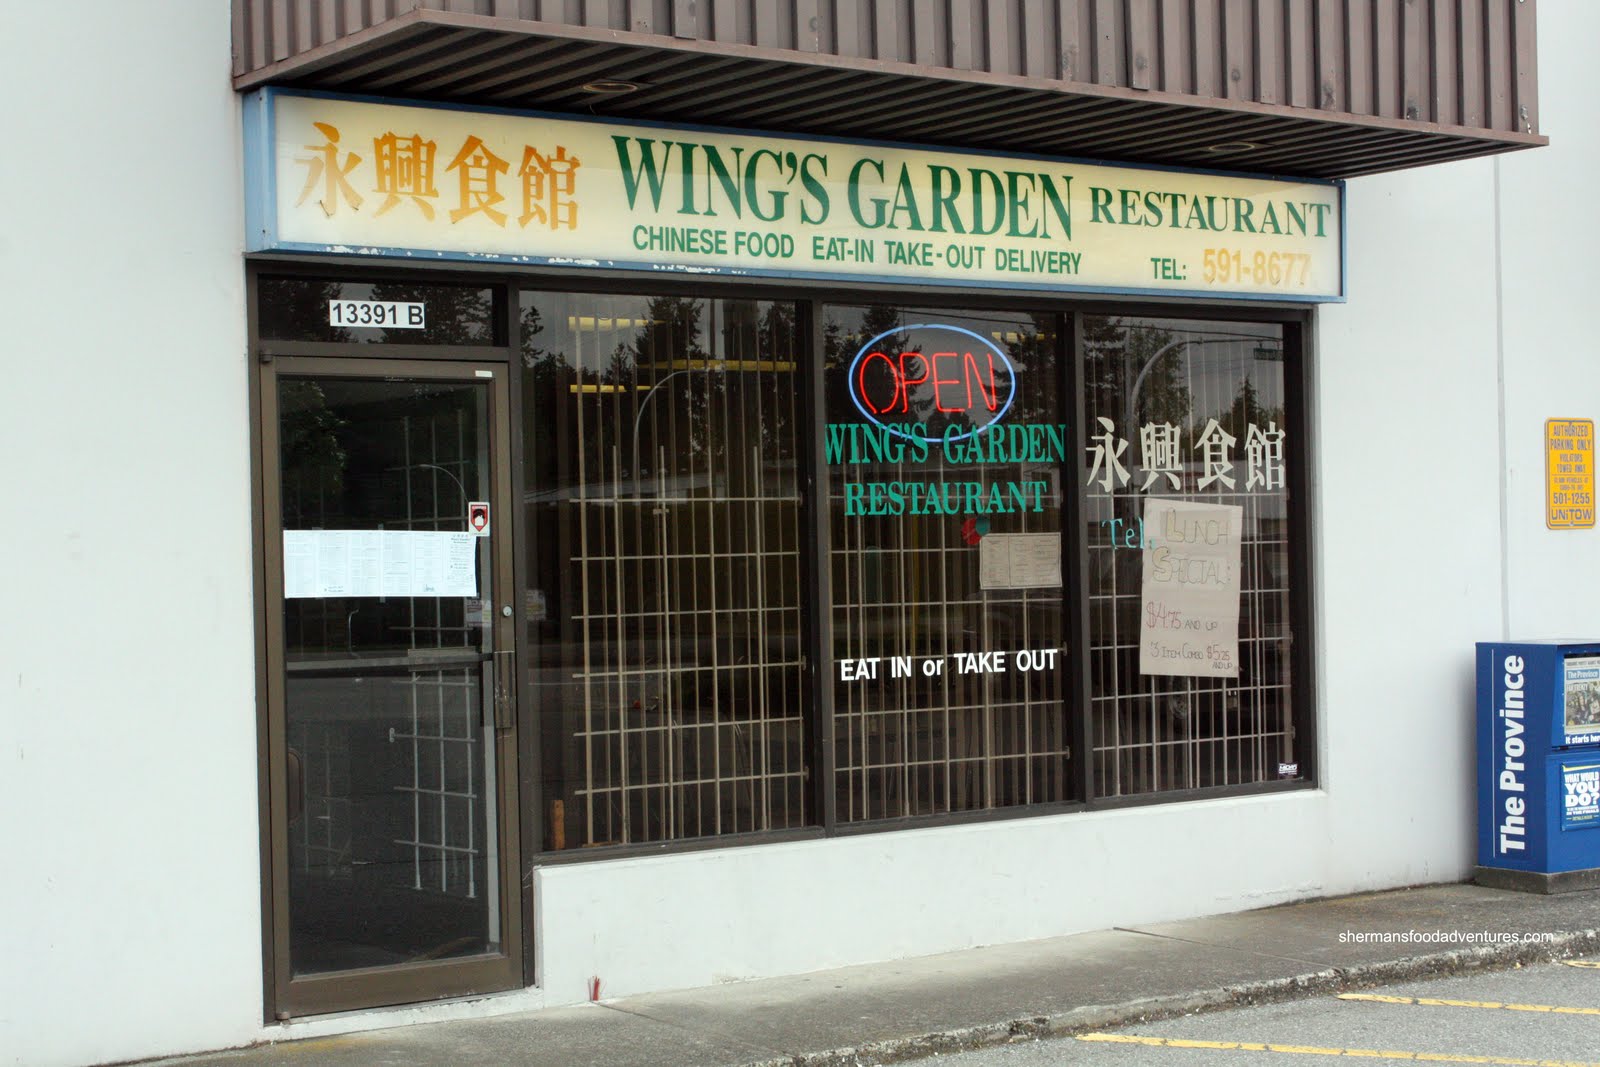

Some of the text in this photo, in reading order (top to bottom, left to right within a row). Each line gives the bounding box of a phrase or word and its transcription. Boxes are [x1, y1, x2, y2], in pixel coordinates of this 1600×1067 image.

[296, 121, 582, 231] 永興食館
[612, 135, 1331, 241] WING'S GARDEN RESTAURANT
[633, 224, 728, 255] CHINESE
[735, 231, 794, 258] FOOD
[812, 236, 875, 264] EAT-IN
[994, 248, 1082, 275] DELIVERY
[1151, 248, 1311, 288] TEL: 591-8677
[332, 303, 423, 325] 13391 B
[858, 352, 998, 415] OPEN
[824, 422, 1066, 465] WING'S GARDEN
[1550, 438, 1592, 451] PARKING ONLY
[1553, 425, 1589, 437] AUTHORIZED
[1086, 417, 1286, 493] 永興食館
[844, 481, 1047, 516] RESTAURANT
[1553, 492, 1590, 504] 501-1255
[1166, 507, 1230, 545] LUNCH
[1184, 619, 1201, 631] AND
[1205, 620, 1219, 632] UP
[840, 648, 1058, 681] EAT IN or TAKE OUT
[1499, 655, 1525, 854] The Province
[1571, 735, 1589, 744] starts
[1564, 773, 1580, 783] WHAT
[1564, 780, 1600, 795] YOU
[1565, 792, 1600, 807] DO?
